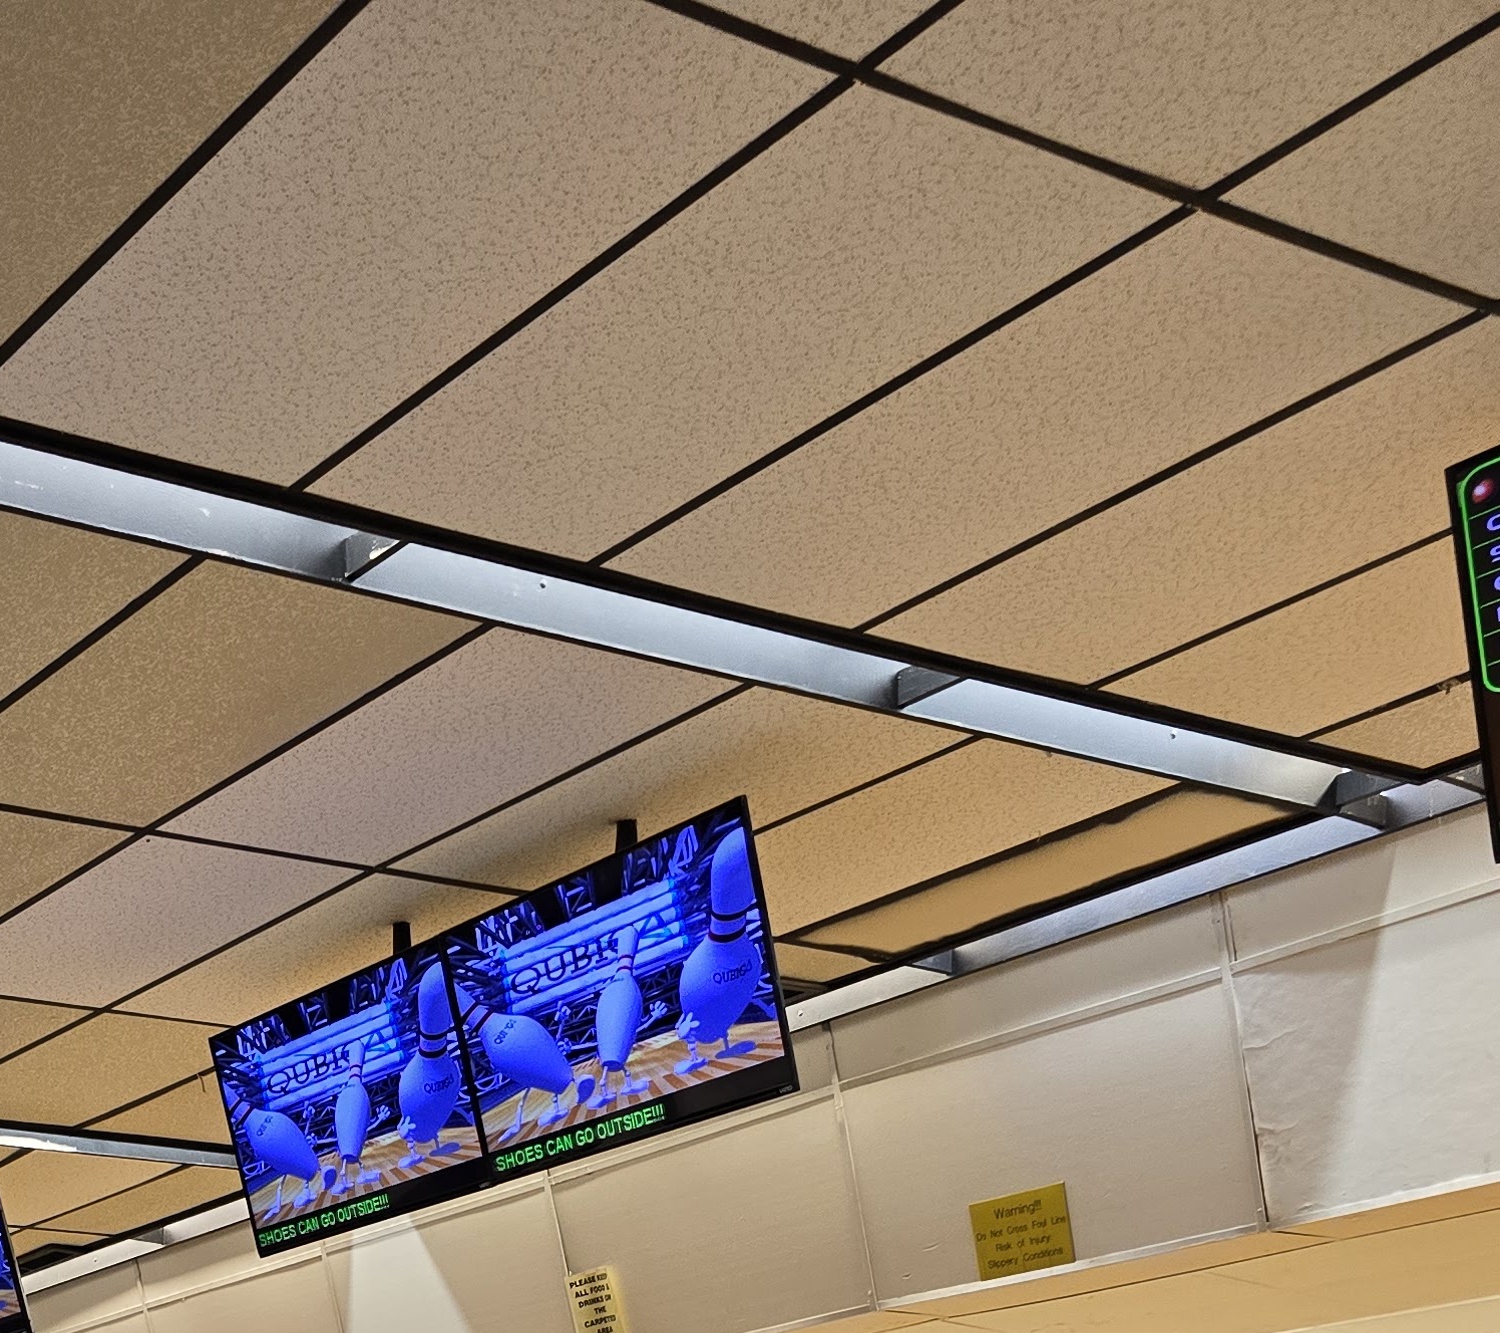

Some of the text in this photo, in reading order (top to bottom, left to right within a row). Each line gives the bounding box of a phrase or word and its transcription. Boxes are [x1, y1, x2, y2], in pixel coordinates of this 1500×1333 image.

[496, 1103, 665, 1171] SHOES CAN GO OUTSIDE!!!
[259, 1194, 389, 1247] SHOES CAN GO OUTSIDE!!!
[976, 1216, 1066, 1242] Do Not Cross Foul Line
[996, 1235, 1051, 1252] Risk of Injury
[988, 1247, 1063, 1269] Slippery Conditions
[569, 1275, 596, 1289] PLEASE
[575, 1289, 589, 1299] ALL
[578, 1296, 604, 1308] DRINKS
